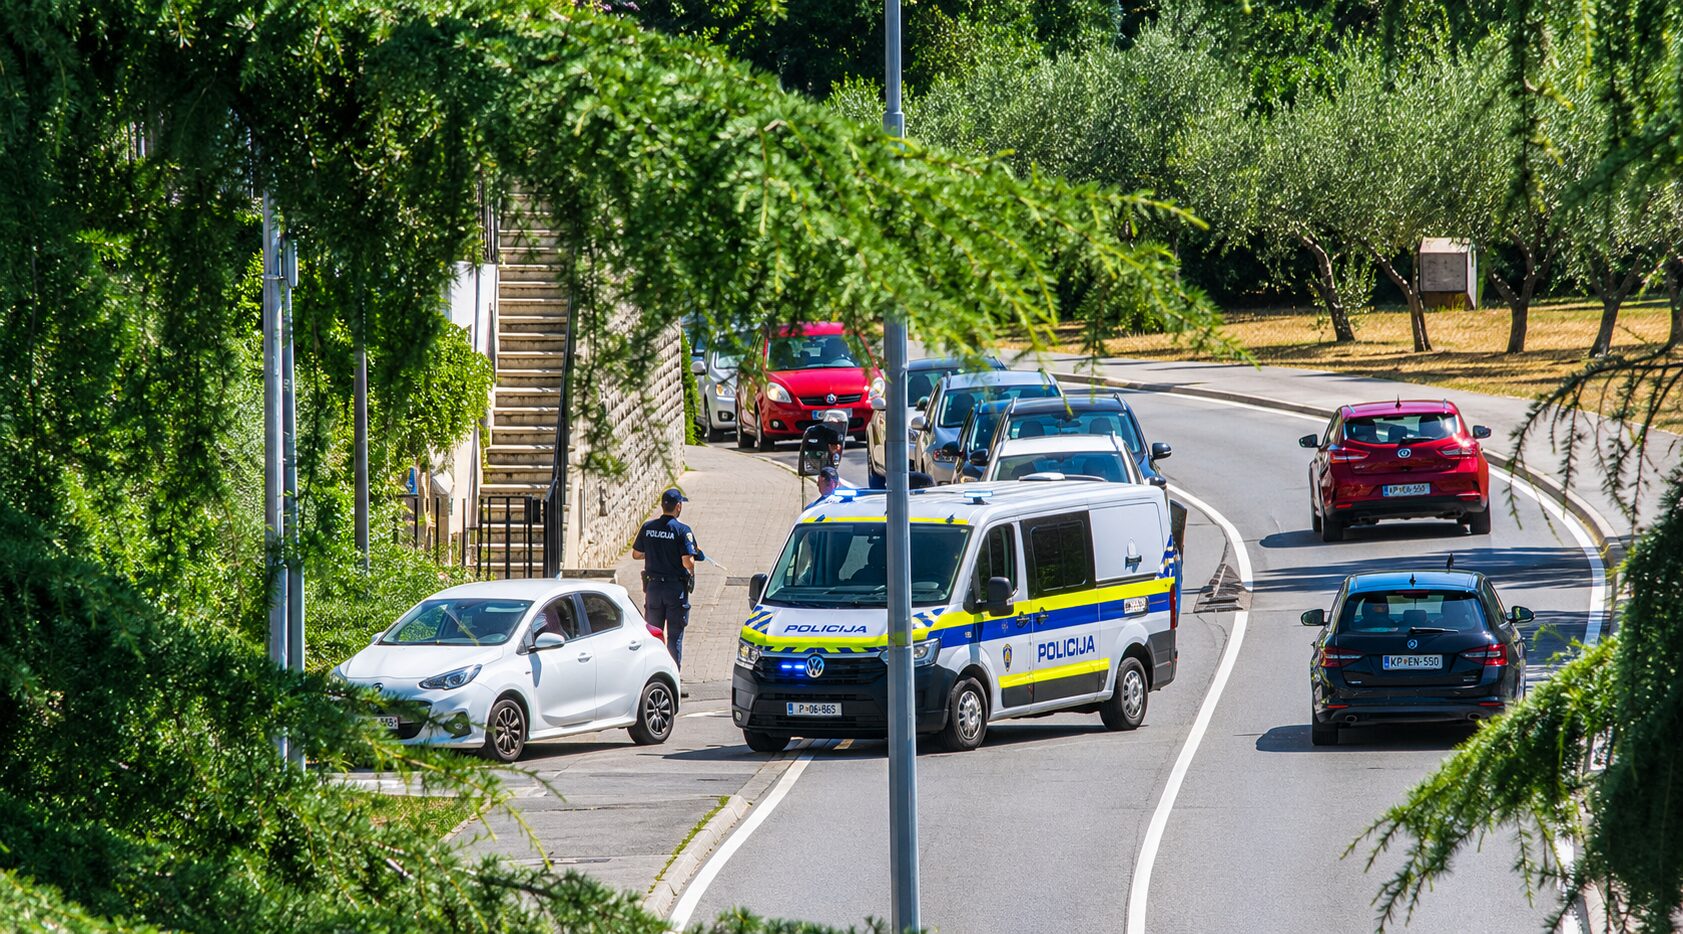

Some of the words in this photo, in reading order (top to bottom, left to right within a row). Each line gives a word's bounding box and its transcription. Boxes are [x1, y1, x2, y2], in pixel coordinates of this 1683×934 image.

[645, 529, 675, 540] POLICIJA
[784, 624, 867, 633] POLICIJA
[1037, 634, 1096, 663] POLICIJA
